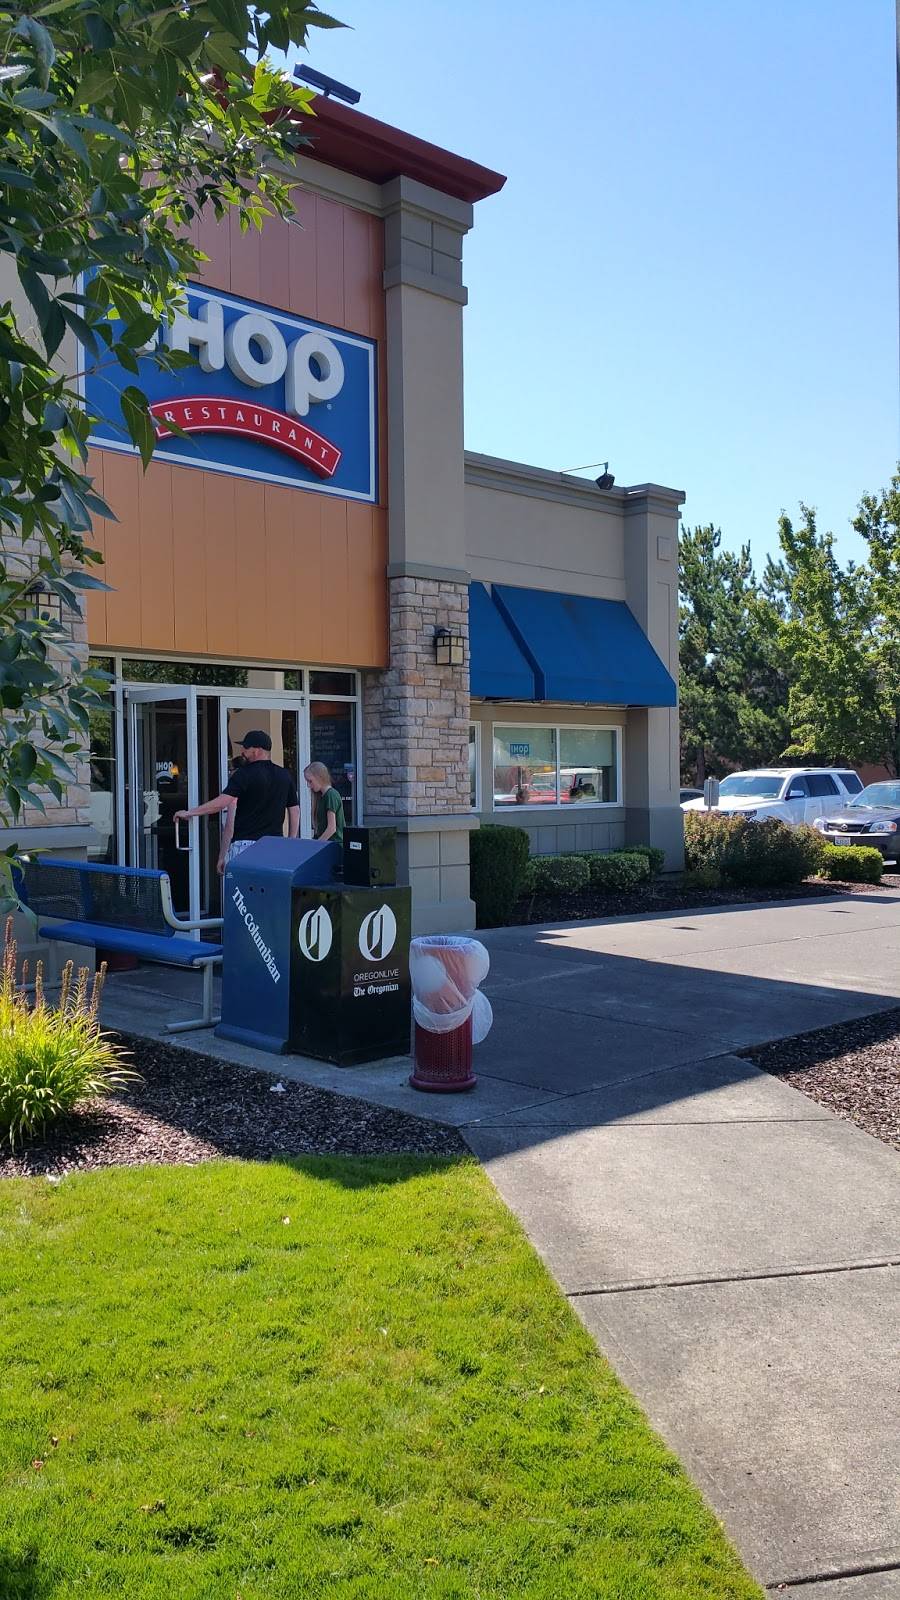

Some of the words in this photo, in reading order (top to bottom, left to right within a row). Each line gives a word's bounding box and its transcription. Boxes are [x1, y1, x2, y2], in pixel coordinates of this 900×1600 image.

[164, 406, 328, 459] RESTAURANT
[232, 886, 248, 916] The
[244, 913, 281, 984] Columbian
[353, 968, 399, 982] OREGONLIVE
[353, 986, 366, 997] The
[367, 983, 399, 995] Oregonian
